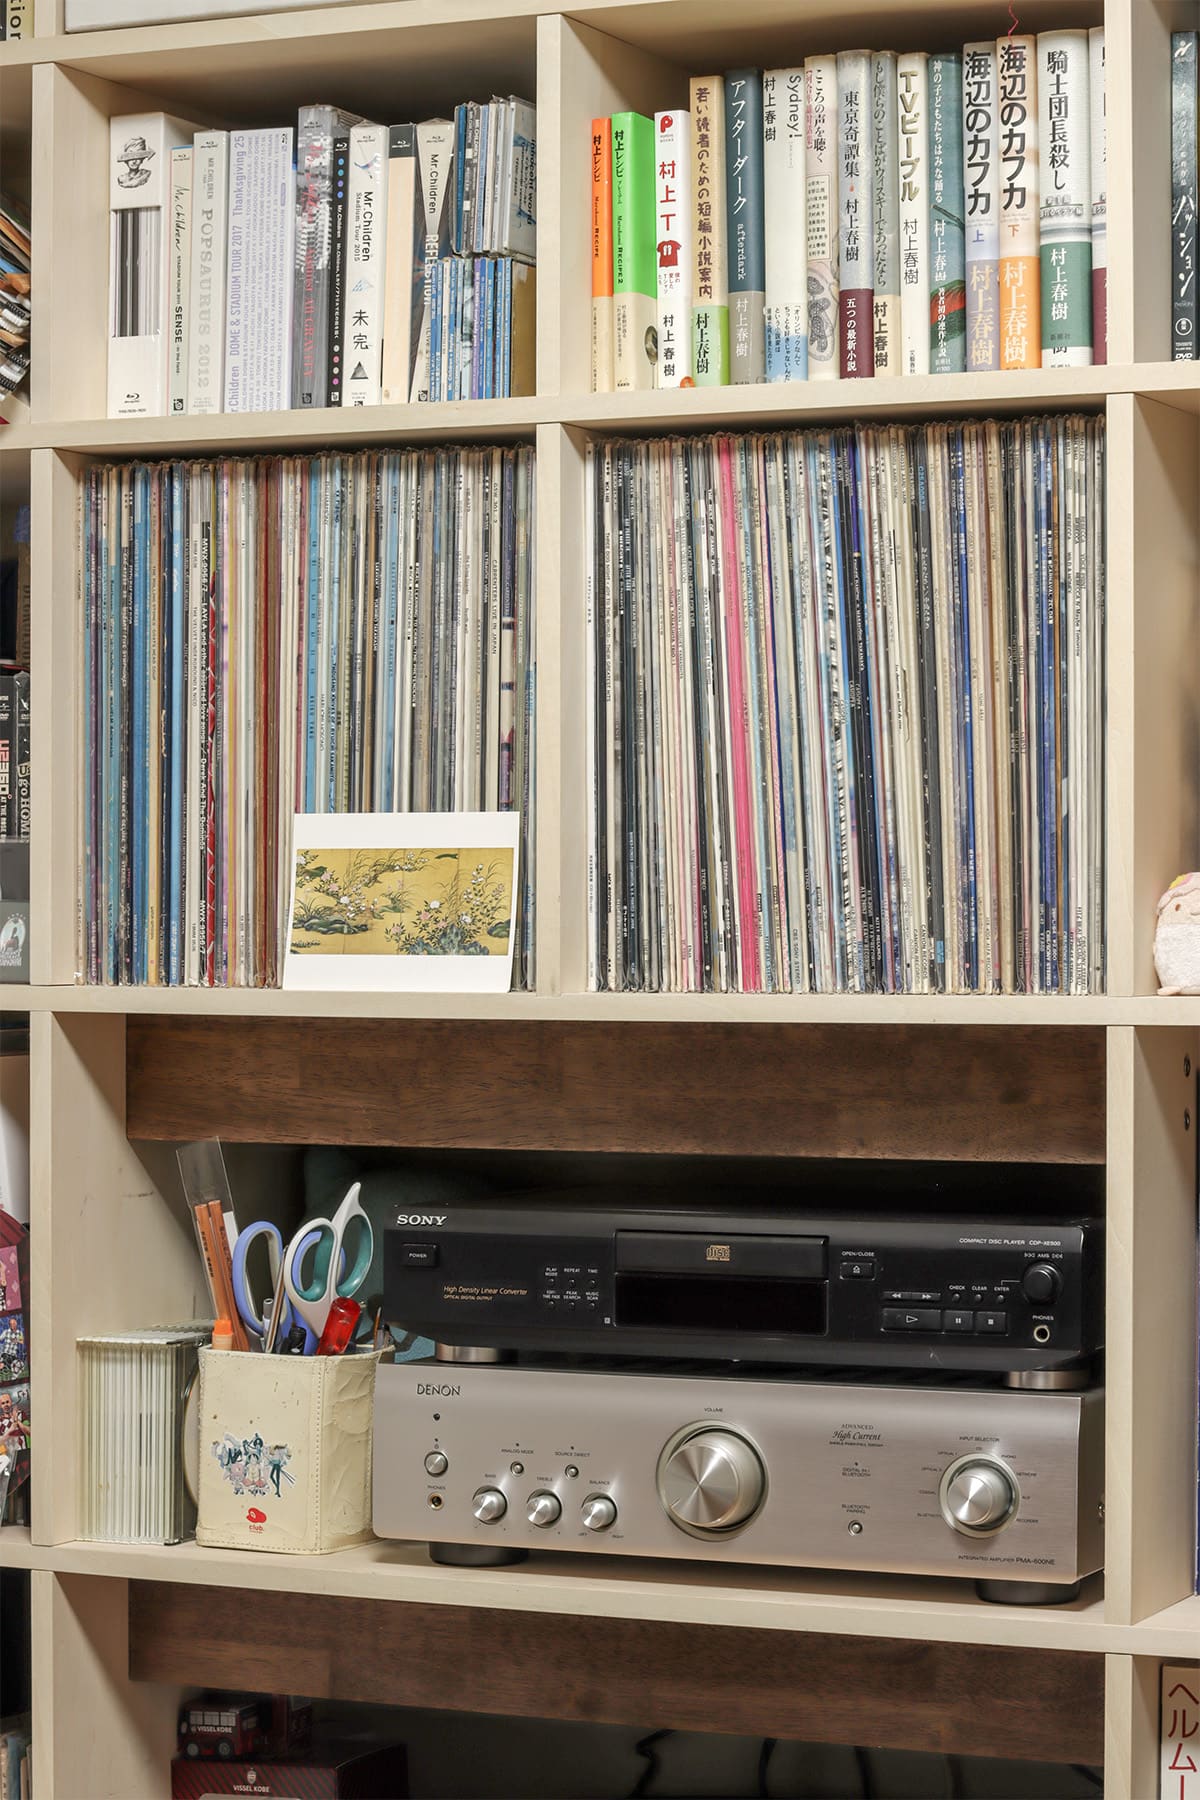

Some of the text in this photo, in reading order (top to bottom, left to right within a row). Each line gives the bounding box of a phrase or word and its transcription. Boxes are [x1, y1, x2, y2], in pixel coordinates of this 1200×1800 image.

[764, 78, 777, 141] 村上春樹
[787, 75, 802, 138] Sydney!
[813, 69, 826, 163] こころの声を聴く
[843, 90, 860, 178] 東京奇譚集
[900, 70, 921, 202] TVピープル
[933, 60, 944, 204] 神の子どもたちはみな踊る
[965, 50, 992, 217] 海辺のカフカ
[999, 43, 1028, 211] 海辺のカフカ
[1047, 49, 1071, 191] 騎士団長殺し
[234, 135, 245, 148] 25
[593, 134, 602, 183] 村上レシピ
[615, 130, 625, 178] 村上レシピ
[730, 80, 748, 215] アフターダーク
[207, 169, 215, 200] CHILDREN
[232, 151, 247, 216] Thanksgiving
[428, 154, 440, 214] Mr.Children
[696, 87, 713, 299] 若い読者のための短編小説案内
[874, 60, 889, 287] もし僕らのことばがウィスキーであったなら
[231, 225, 243, 247] 2017
[362, 192, 374, 261] Mr.Children
[527, 192, 536, 225] world
[844, 198, 860, 262] 村上春樹
[971, 228, 985, 244] 上
[1007, 224, 1020, 238] 下
[231, 249, 243, 273] TOUR
[736, 222, 747, 281] afterdark
[903, 218, 918, 285] 村上春樹
[933, 219, 947, 282] 村上春樹
[198, 208, 214, 388] POPSAURUS 2012
[230, 275, 242, 316] STADIUM
[970, 264, 995, 366] 村上春樹
[1004, 262, 1028, 363] 村上春樹
[1051, 248, 1070, 321] 村上春樹
[229, 318, 241, 326] &
[229, 329, 241, 356] DOME
[303, 317, 316, 377] GRAVITY
[352, 309, 370, 350] 未完
[663, 314, 676, 377] 村上春樹
[696, 313, 711, 374] 村上春樹
[735, 298, 749, 358] 村上春樹
[846, 298, 857, 371] 五つの最新小説
[873, 300, 889, 368] 村上春樹
[397, 1215, 447, 1226] SONY
[841, 1250, 875, 1258] OPEN/CLOSE
[444, 1286, 528, 1297] High Density Linear Converter
[416, 1384, 461, 1397] DENON
[832, 1430, 881, 1442] High Current
[216, 1726, 233, 1734] KOBE
[233, 1785, 270, 1793] VISSEL KOBE
